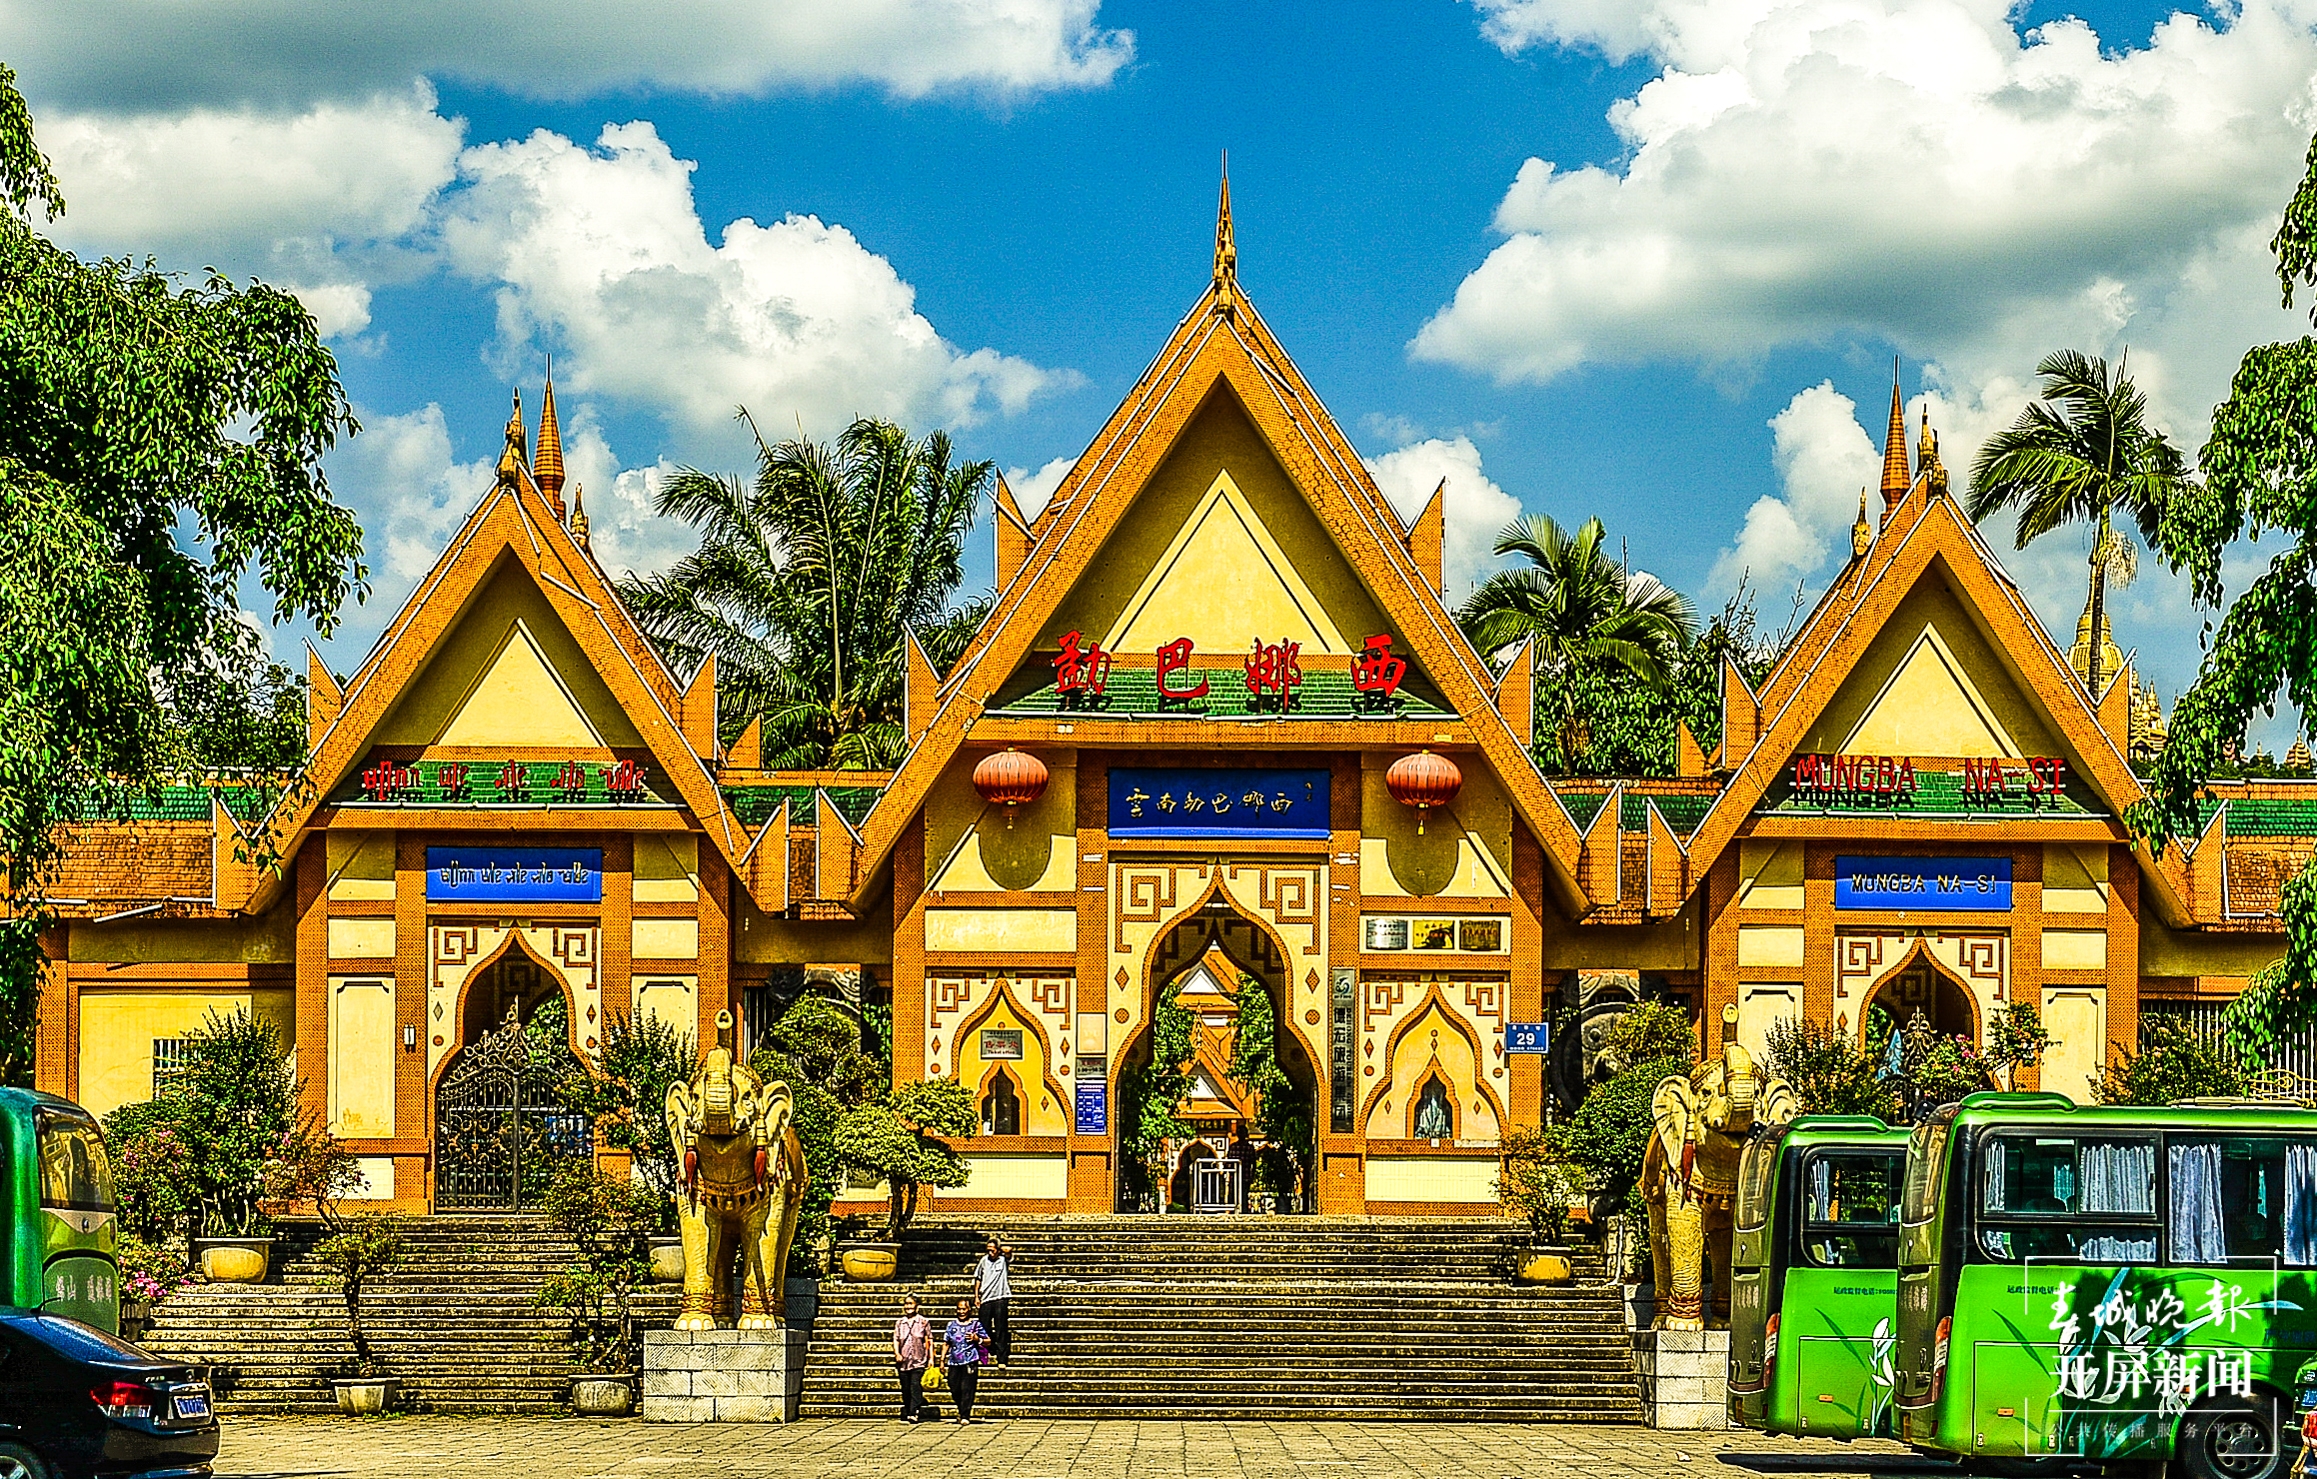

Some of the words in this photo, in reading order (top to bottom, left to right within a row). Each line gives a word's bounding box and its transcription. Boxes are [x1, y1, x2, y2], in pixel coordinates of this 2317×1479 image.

[1796, 754, 1917, 793] MUNGBA
[1851, 873, 1926, 894] MUNGBA
[1516, 1032, 1535, 1046] 29
